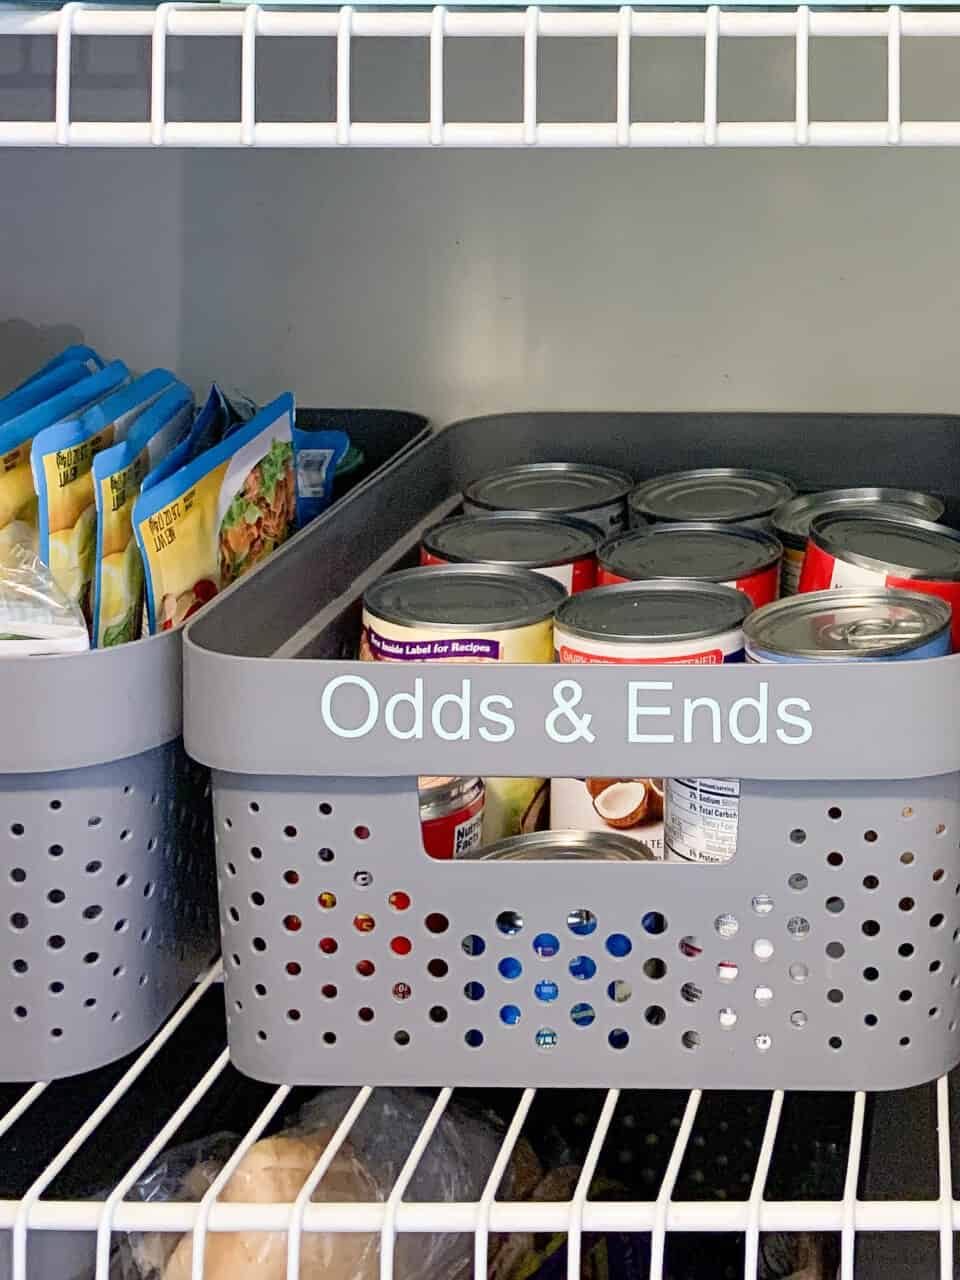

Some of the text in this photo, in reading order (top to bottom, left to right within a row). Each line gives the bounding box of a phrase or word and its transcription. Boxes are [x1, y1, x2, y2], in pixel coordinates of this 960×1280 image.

[406, 643, 431, 656] Label
[434, 640, 449, 654] for
[451, 642, 491, 655] Recipes
[320, 674, 814, 745] Odds & Ends
[699, 806, 714, 817] Total
[698, 852, 720, 864] Protein
